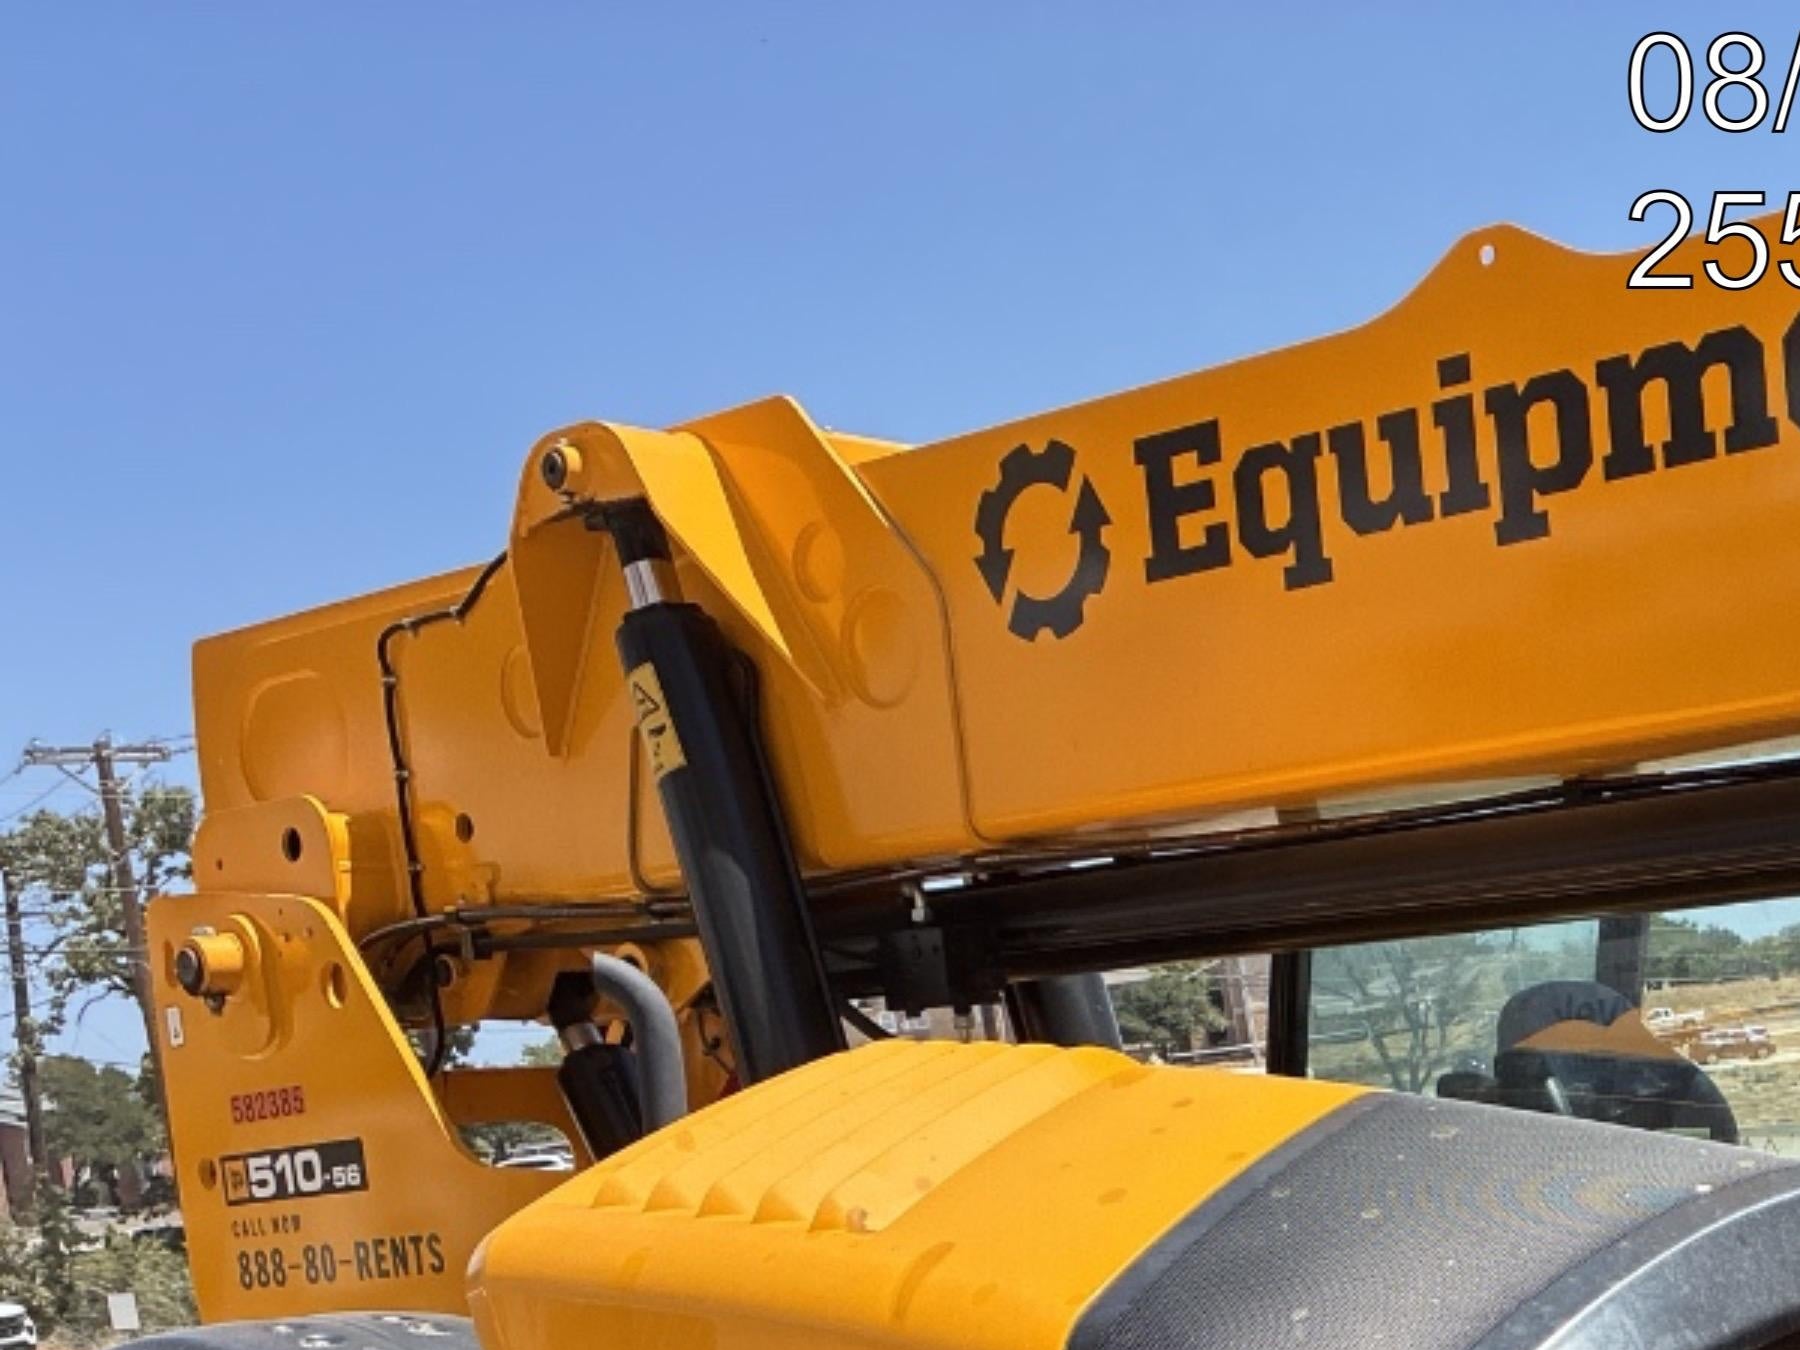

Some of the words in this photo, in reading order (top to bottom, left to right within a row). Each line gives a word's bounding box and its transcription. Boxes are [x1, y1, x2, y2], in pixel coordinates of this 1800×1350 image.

[230, 1085, 305, 1125] 582385
[231, 1217, 265, 1238] CALL
[271, 1214, 301, 1235] NOW
[238, 1233, 445, 1291] 888-80-RENTS
